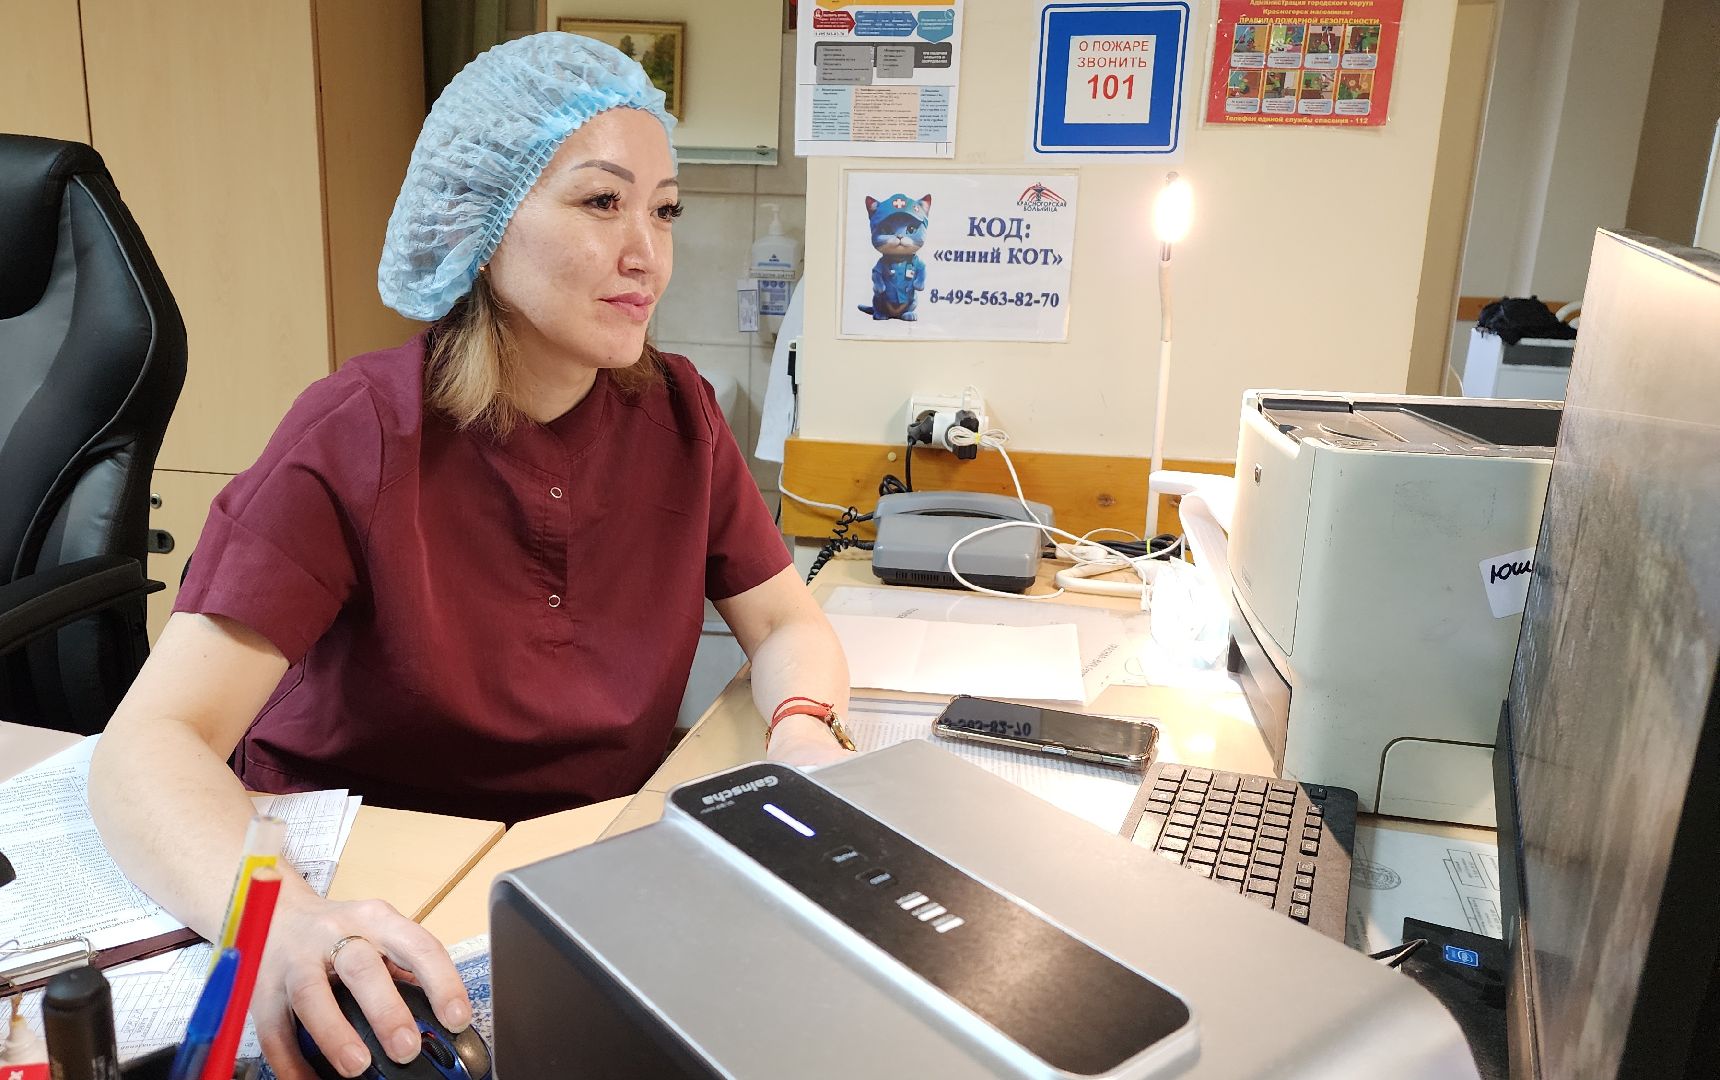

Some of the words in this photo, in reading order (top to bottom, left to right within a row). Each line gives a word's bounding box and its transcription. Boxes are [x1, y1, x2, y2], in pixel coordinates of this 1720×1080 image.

[1079, 41, 1088, 51] О
[1092, 40, 1149, 52] ПОЖАРЕ
[1077, 57, 1147, 68] ЗВОНИТЬ
[1087, 74, 1135, 100] 101
[967, 216, 1031, 243] КОД:
[933, 247, 1001, 264] «синий
[1007, 247, 1063, 265] КОТ»
[929, 288, 1060, 308] 8-495-563-82-70
[701, 775, 779, 805] Gainscha
